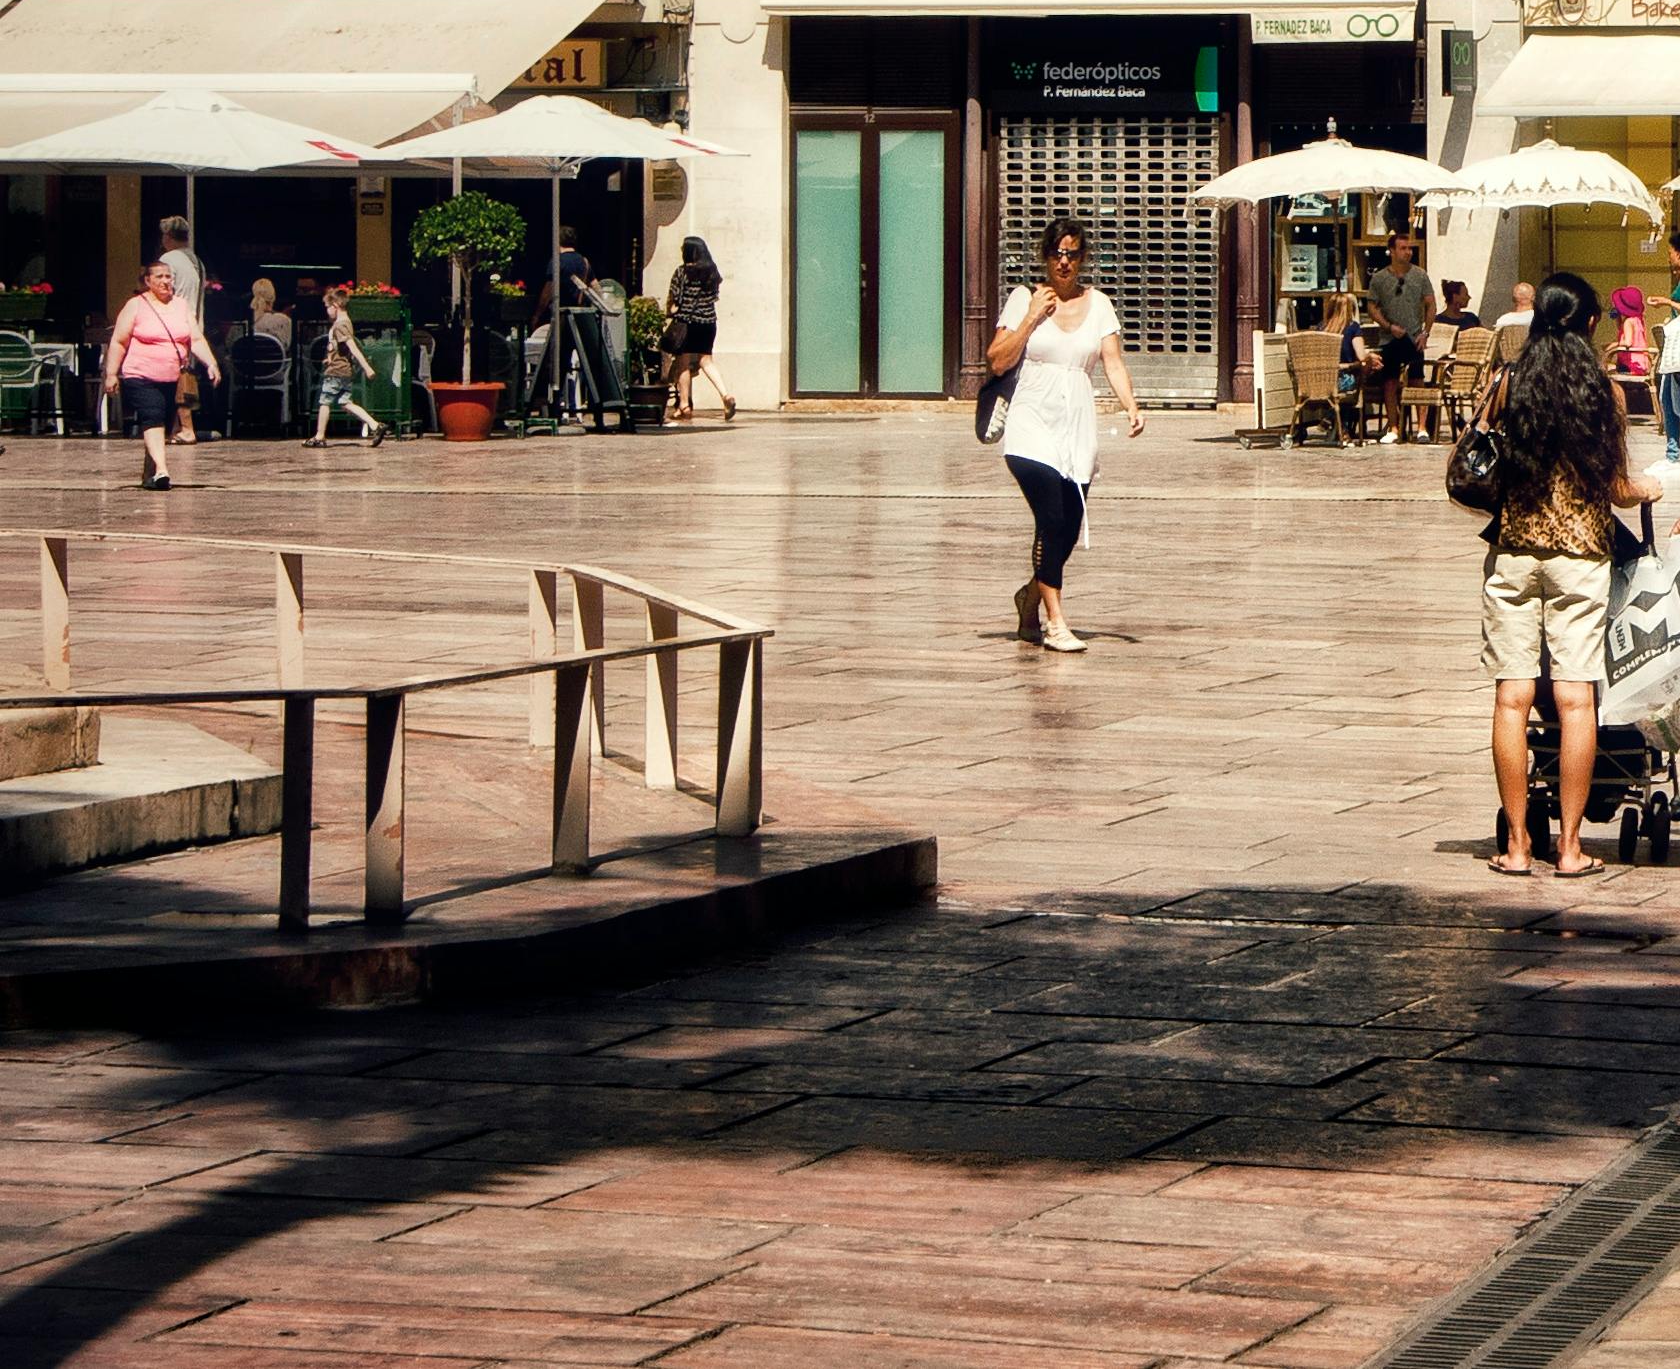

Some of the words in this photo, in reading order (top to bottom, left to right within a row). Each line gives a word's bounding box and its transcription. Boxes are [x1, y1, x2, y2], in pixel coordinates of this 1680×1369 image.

[1310, 19, 1332, 34] BACA
[1043, 62, 1161, 84] federópticos
[1043, 85, 1054, 98] P.
[1056, 85, 1116, 98] Fernández
[1117, 85, 1146, 98] Baca
[863, 113, 876, 124] 12
